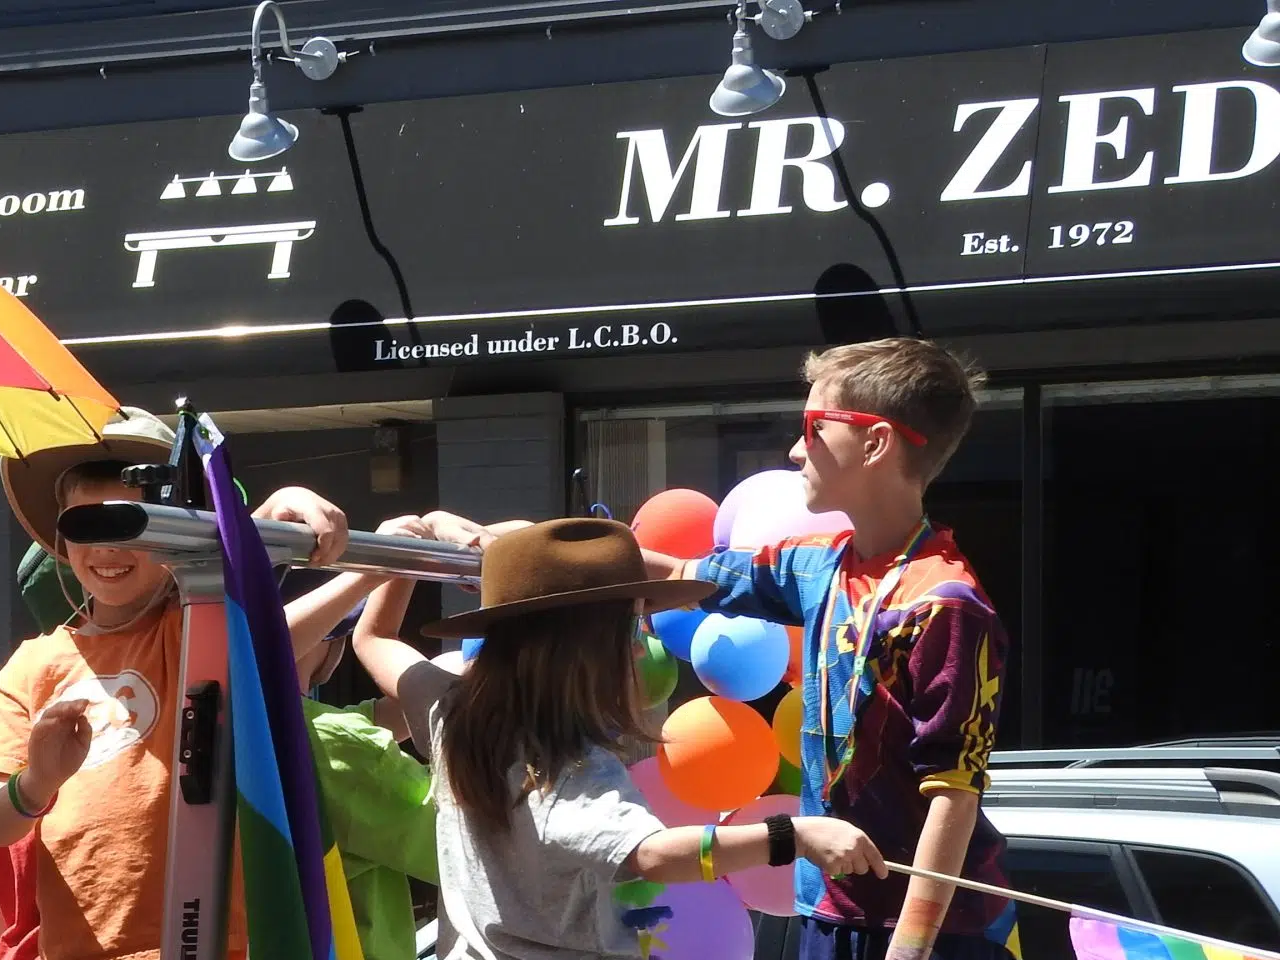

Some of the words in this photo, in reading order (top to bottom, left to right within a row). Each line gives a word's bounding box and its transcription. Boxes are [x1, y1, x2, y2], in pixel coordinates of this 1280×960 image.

[604, 115, 890, 226] MR.
[940, 80, 1280, 202] ZED
[960, 231, 1020, 256] Est.
[1048, 220, 1134, 249] 1972
[374, 334, 479, 361] Licensed
[487, 331, 560, 352] under
[568, 322, 678, 350] L.C.B.O.
